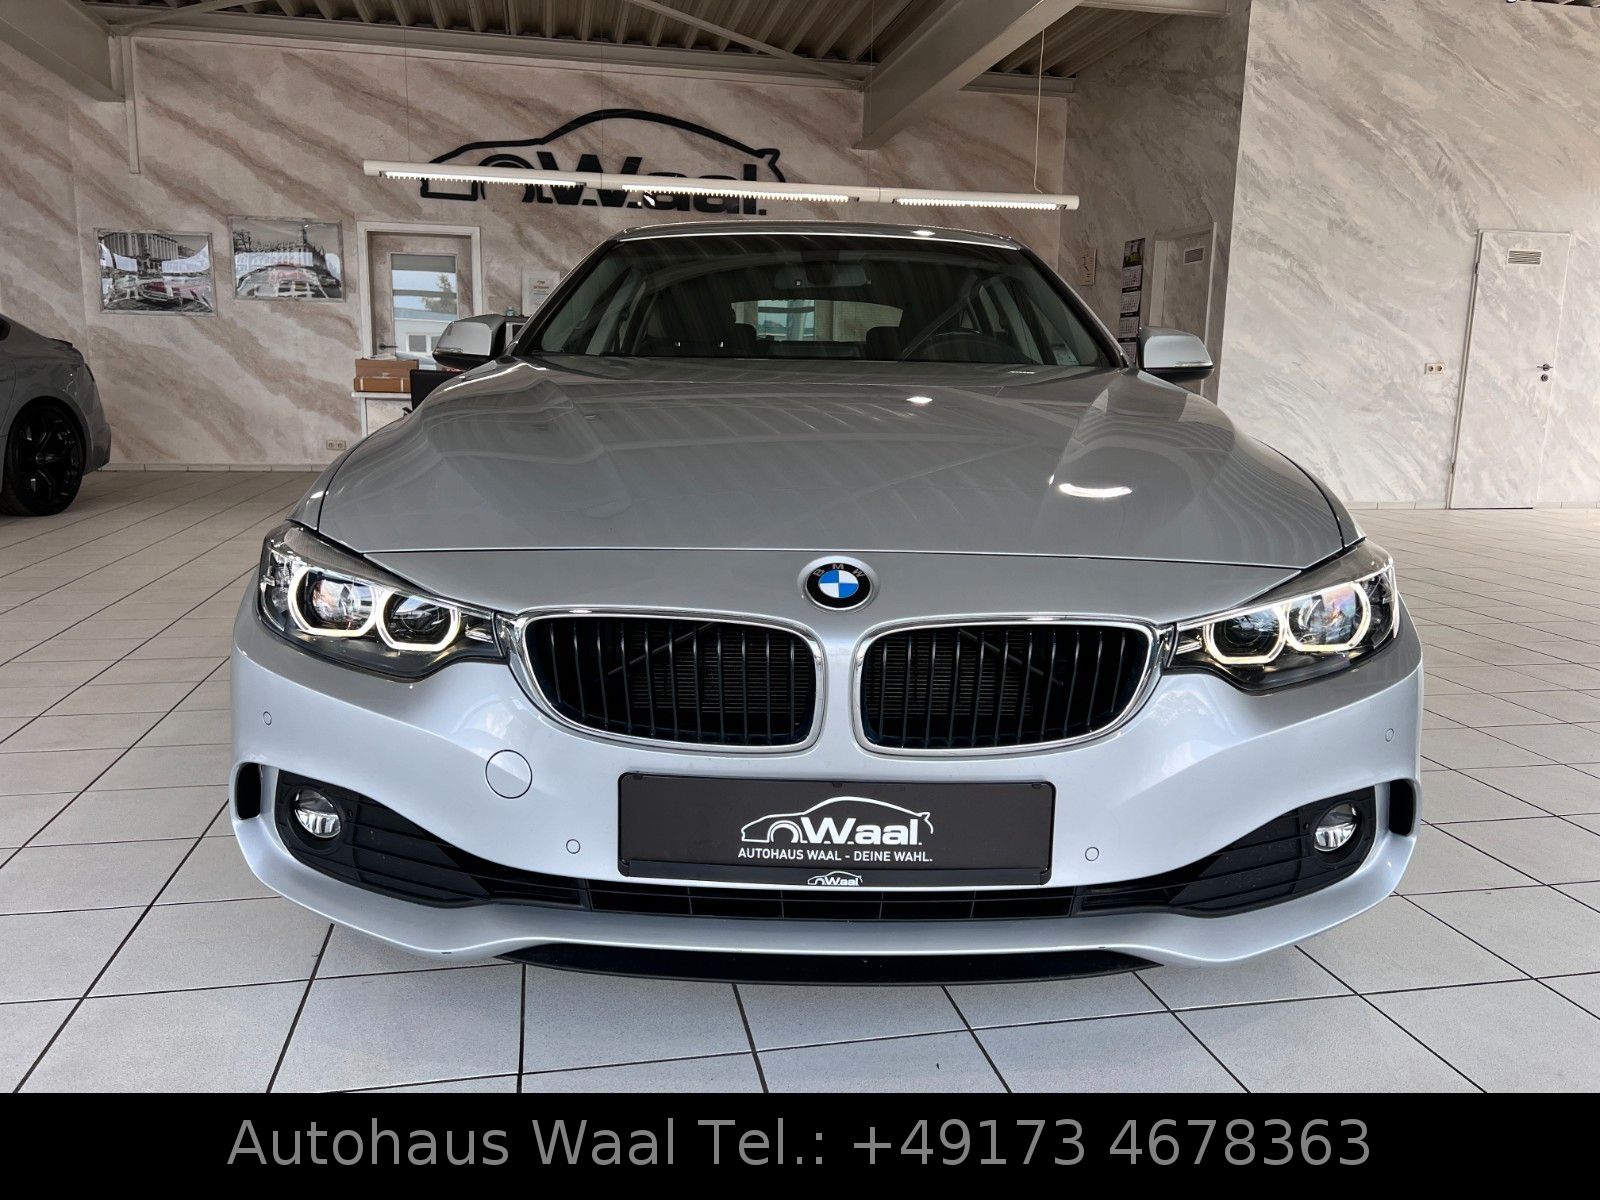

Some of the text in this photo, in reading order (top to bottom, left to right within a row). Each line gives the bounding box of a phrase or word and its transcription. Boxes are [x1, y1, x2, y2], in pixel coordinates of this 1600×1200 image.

[813, 563, 866, 578] BMW
[738, 847, 804, 861] AUTOHAUS
[806, 849, 842, 862] WAAL
[853, 850, 891, 862] DEINE
[894, 851, 933, 863] WAHL.
